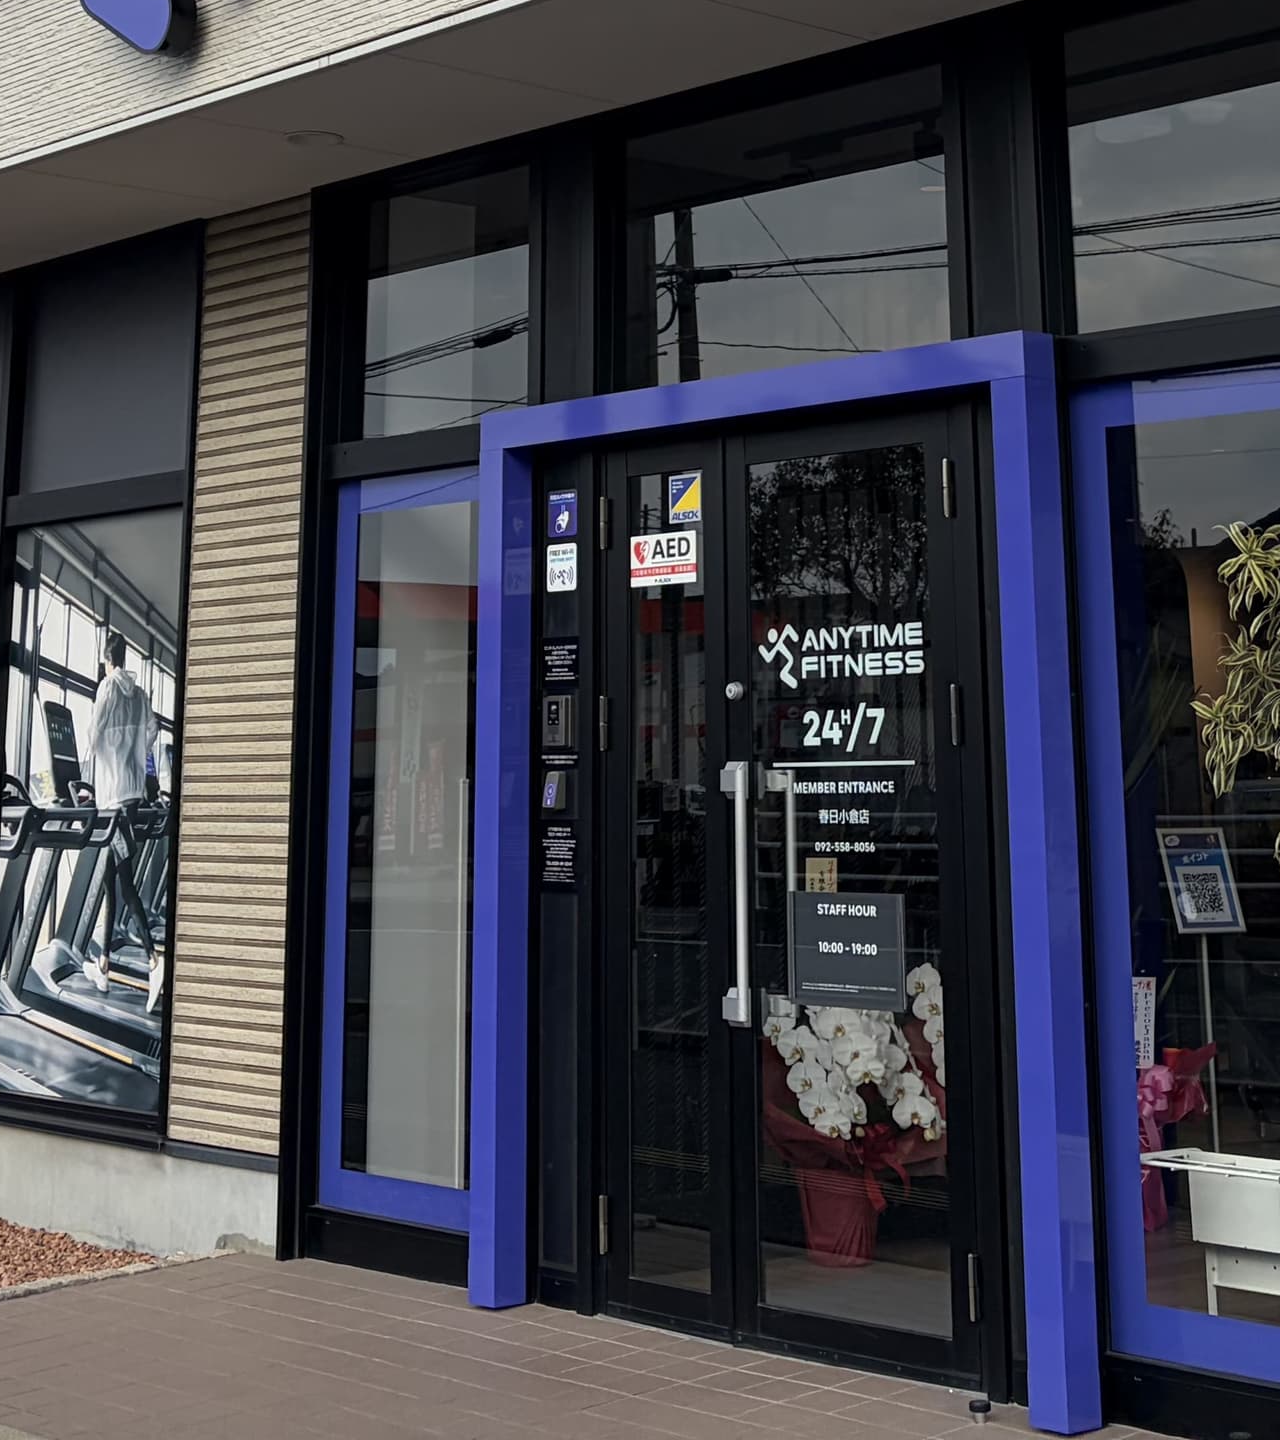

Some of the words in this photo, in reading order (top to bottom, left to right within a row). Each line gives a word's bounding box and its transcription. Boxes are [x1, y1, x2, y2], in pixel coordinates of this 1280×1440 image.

[672, 510, 699, 521] ALSOK
[651, 536, 691, 560] AED
[801, 622, 923, 652] ANYTIME
[801, 650, 925, 679] FITNESS
[802, 702, 885, 752] 24H/7
[793, 782, 836, 794] MEMBER
[838, 781, 895, 793] ENTRANCE
[817, 903, 847, 916] STAFF
[848, 904, 877, 917] HOUR
[818, 941, 843, 953] 10:00
[851, 943, 877, 955] 19:00
